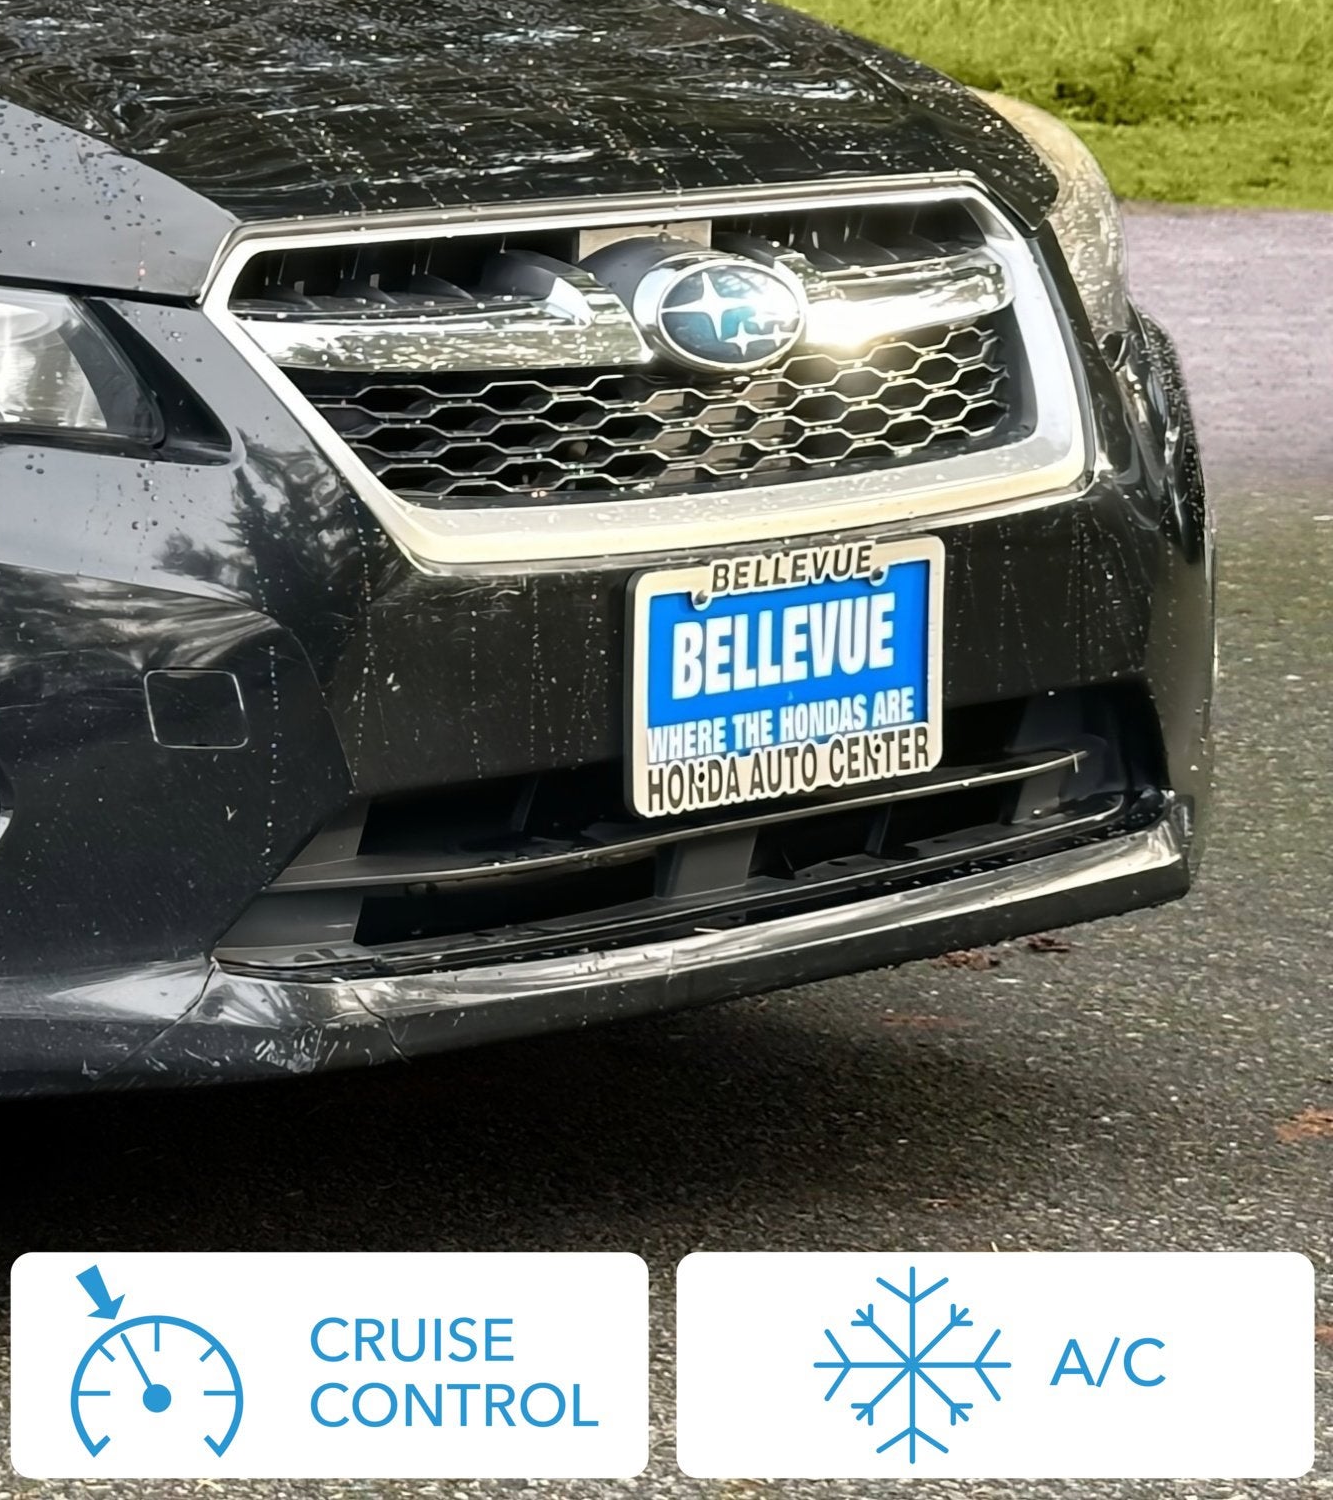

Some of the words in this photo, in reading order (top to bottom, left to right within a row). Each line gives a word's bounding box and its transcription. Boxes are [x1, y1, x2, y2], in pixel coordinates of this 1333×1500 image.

[711, 544, 874, 594] BELLEVUE
[671, 591, 896, 701] BELLEVUE
[646, 717, 726, 761] WHERE
[732, 709, 774, 749] THE
[779, 695, 867, 743] HONDAS
[872, 687, 915, 725] ARE
[646, 761, 741, 813] HONDA
[749, 742, 818, 798] AUTO
[831, 726, 929, 783] CENTER
